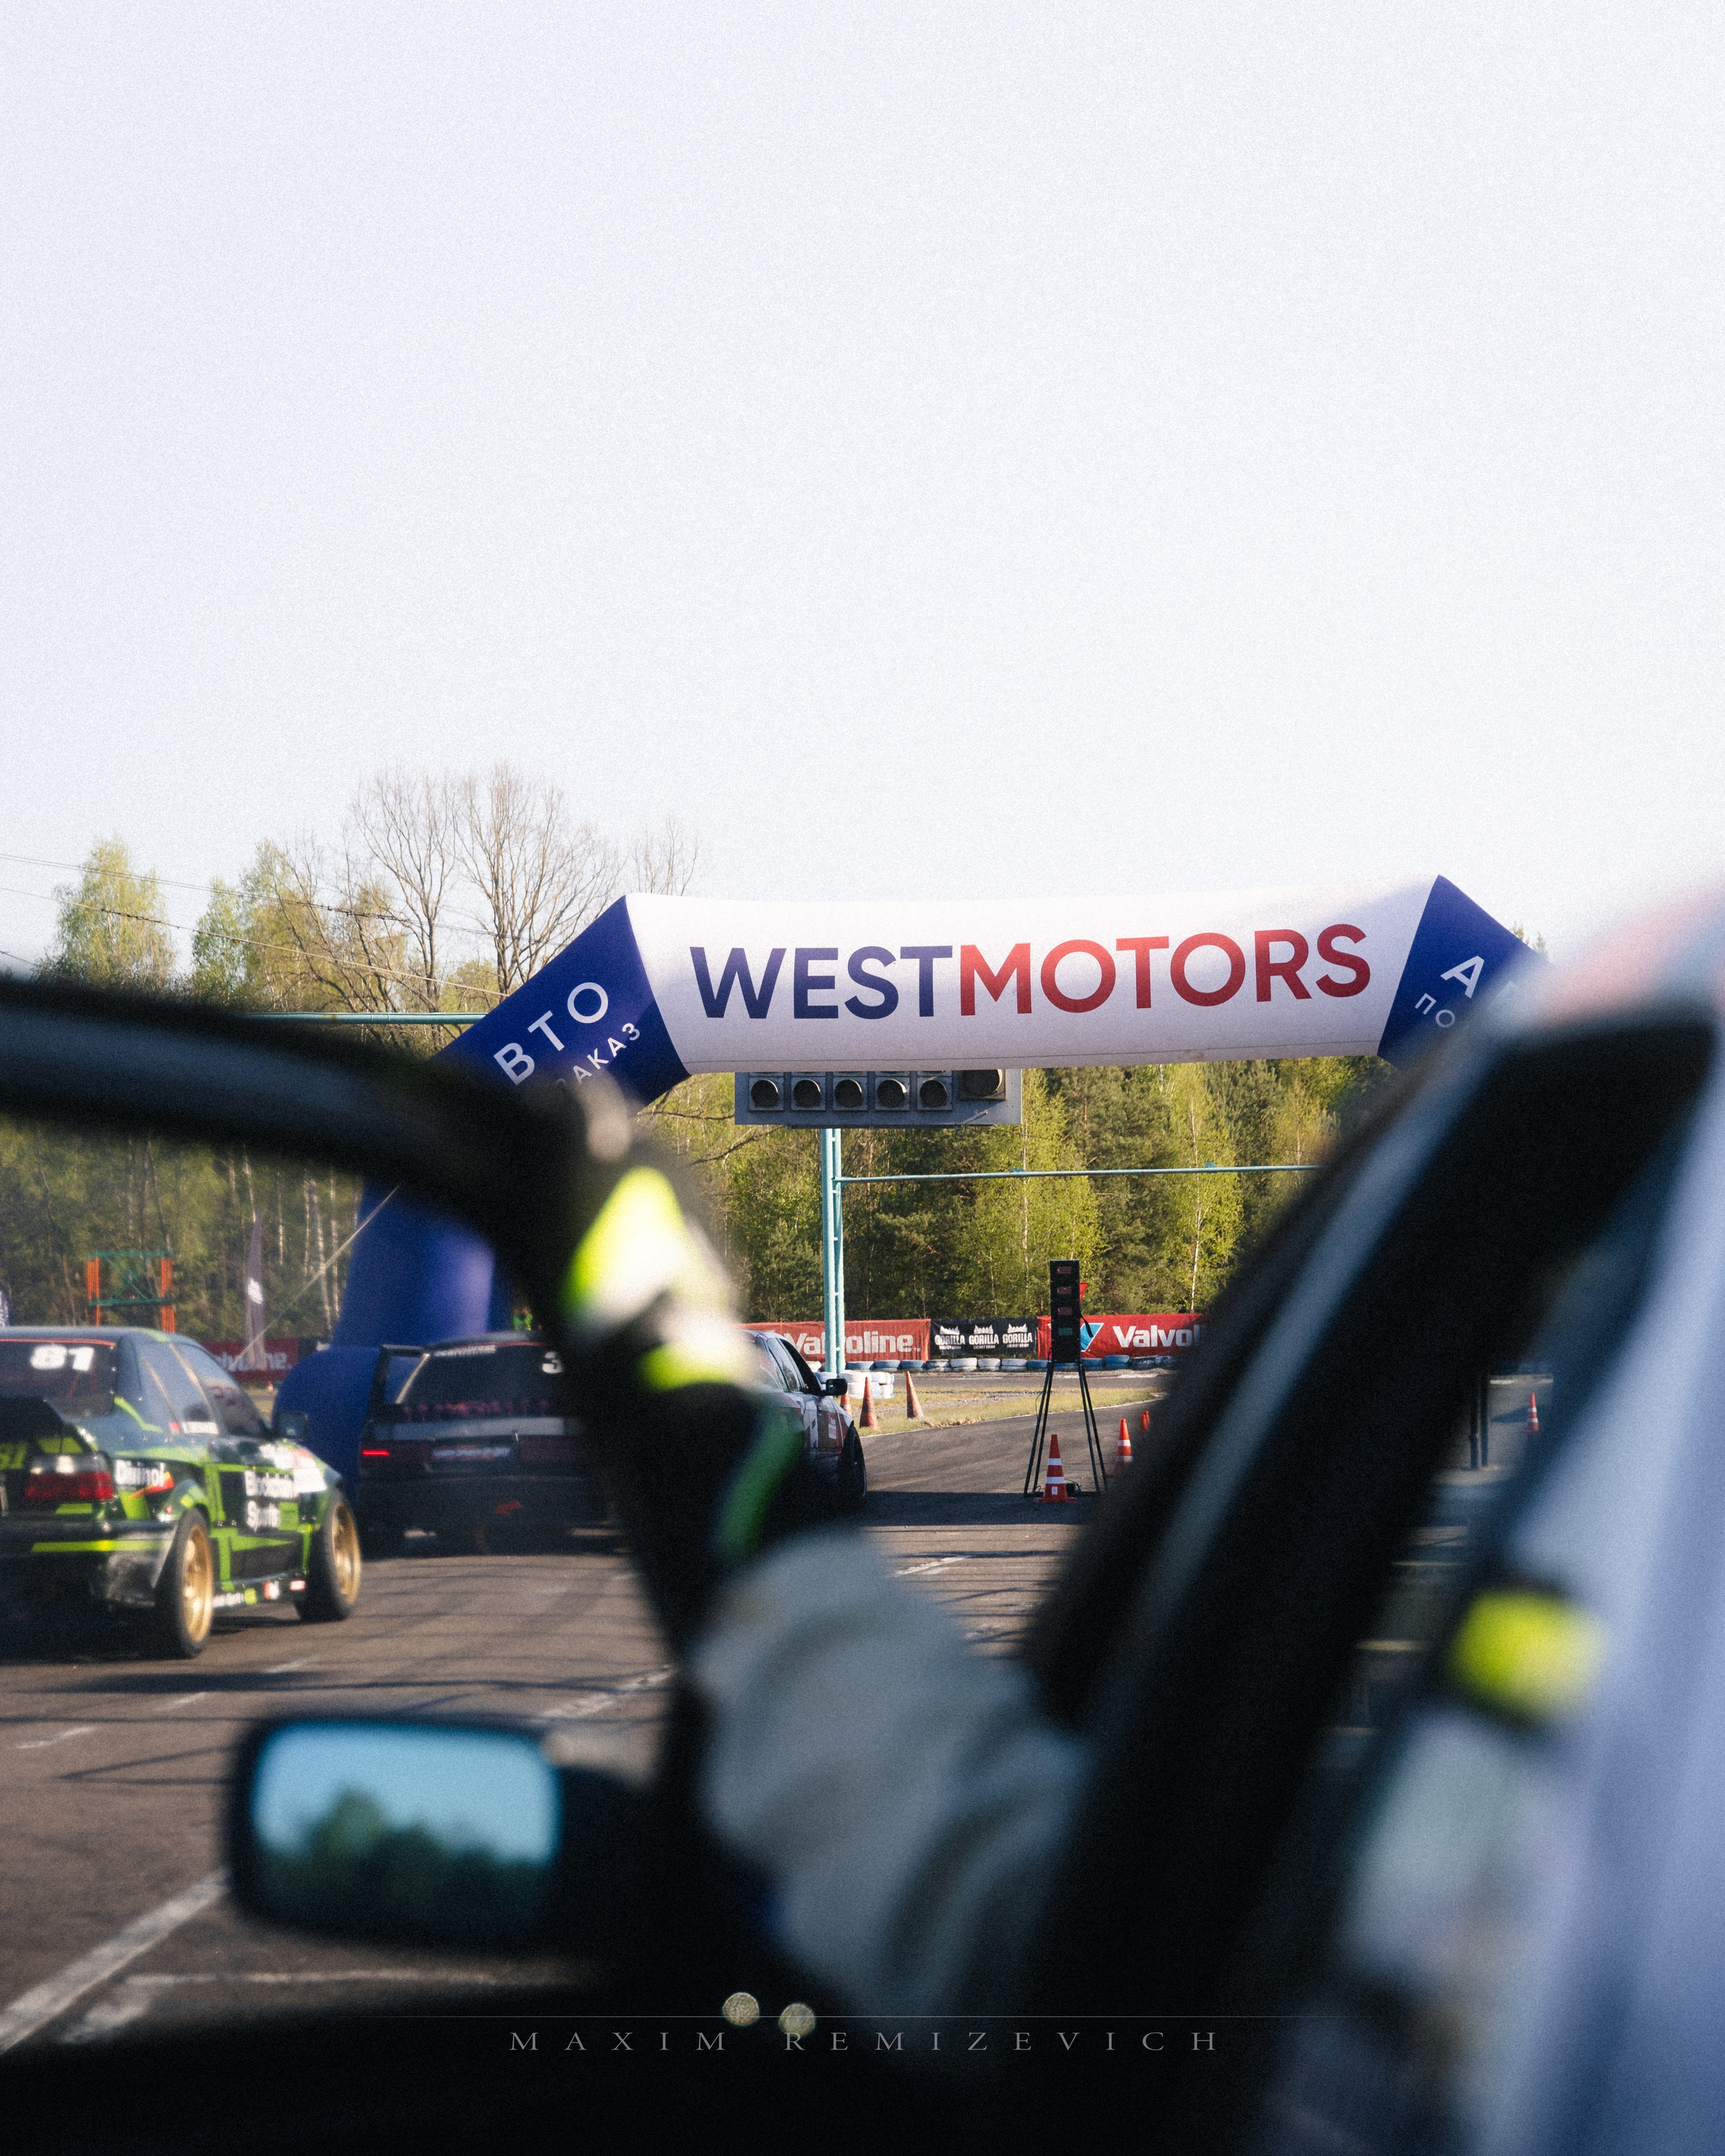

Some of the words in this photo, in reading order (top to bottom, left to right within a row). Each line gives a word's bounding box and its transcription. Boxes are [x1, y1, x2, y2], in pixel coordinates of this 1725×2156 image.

[689, 924, 1371, 1020] WESTMOTORS
[1415, 993, 1455, 1028] ПО
[493, 982, 608, 1085] ВТО
[783, 1331, 914, 1355] Valoline
[935, 1335, 965, 1345] GORILLA
[969, 1334, 999, 1345] GORILLA
[1003, 1333, 1033, 1343] GORILLA
[1112, 1325, 1201, 1348] Valvol
